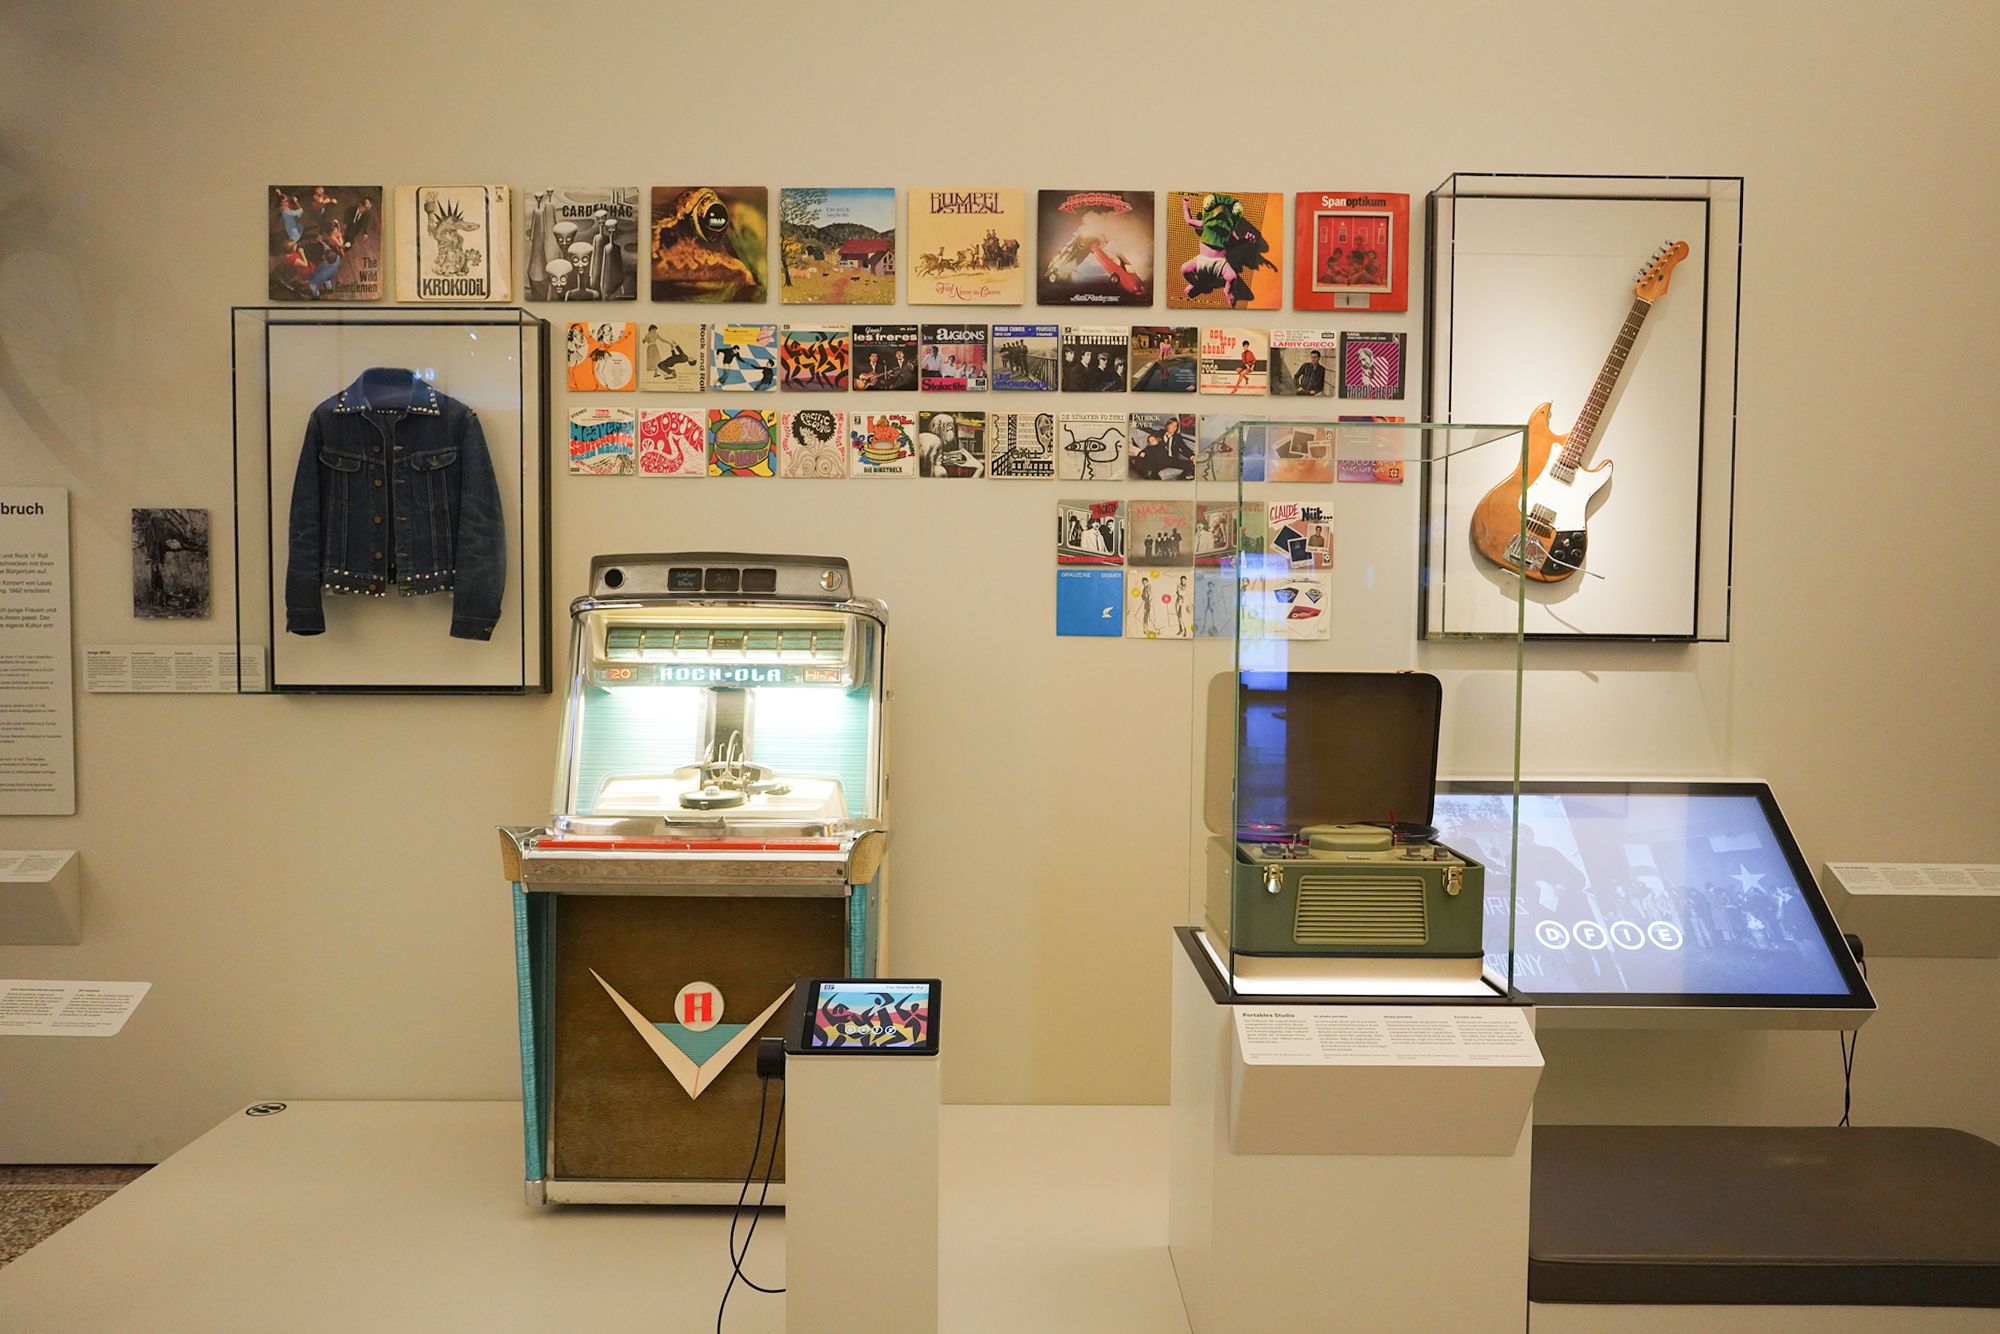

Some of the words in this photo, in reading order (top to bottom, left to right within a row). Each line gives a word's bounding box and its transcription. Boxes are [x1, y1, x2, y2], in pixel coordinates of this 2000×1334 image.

[1321, 196, 1386, 208] Spanoptikum
[362, 257, 378, 268] The
[358, 270, 378, 282] Wild
[1269, 503, 1299, 522] CLAUDE
[1546, 928, 1560, 942] D
[1584, 928, 1596, 942] F
[1658, 928, 1673, 942] E
